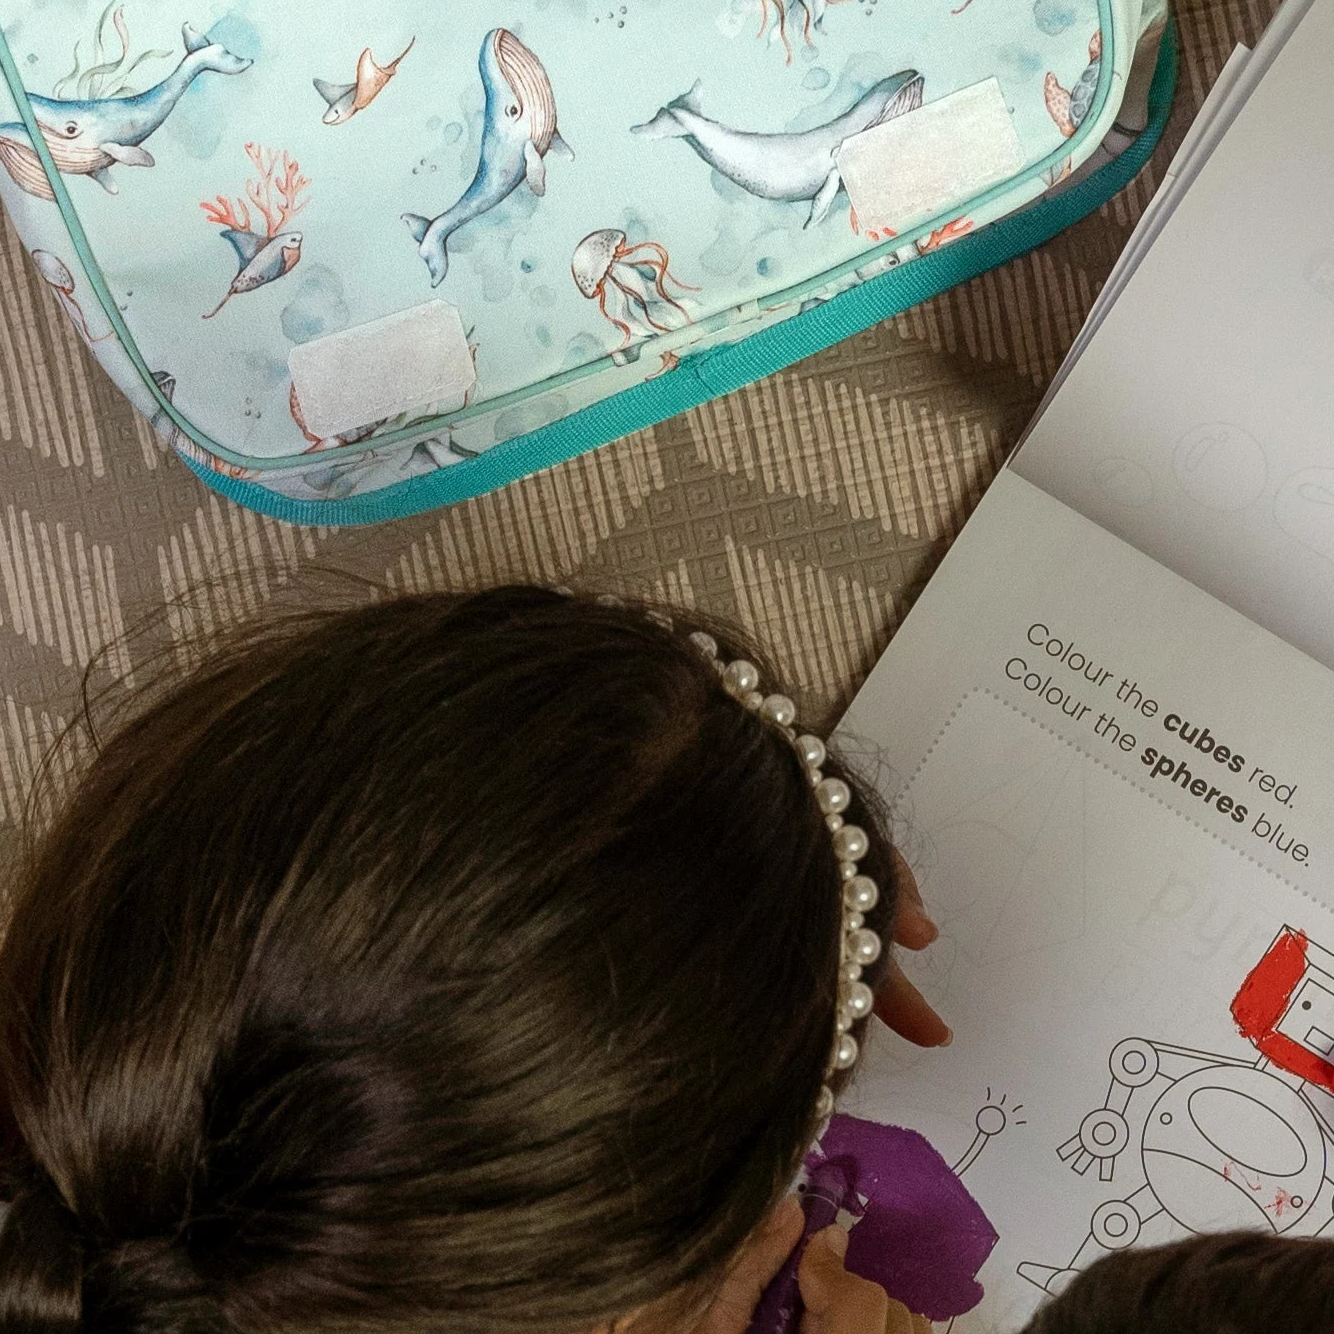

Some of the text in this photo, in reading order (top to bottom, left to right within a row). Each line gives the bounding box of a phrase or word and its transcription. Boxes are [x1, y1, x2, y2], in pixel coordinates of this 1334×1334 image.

[999, 653, 1320, 868] Colour the spheres blue.
[1021, 619, 1303, 809] Colour the cubes red.
